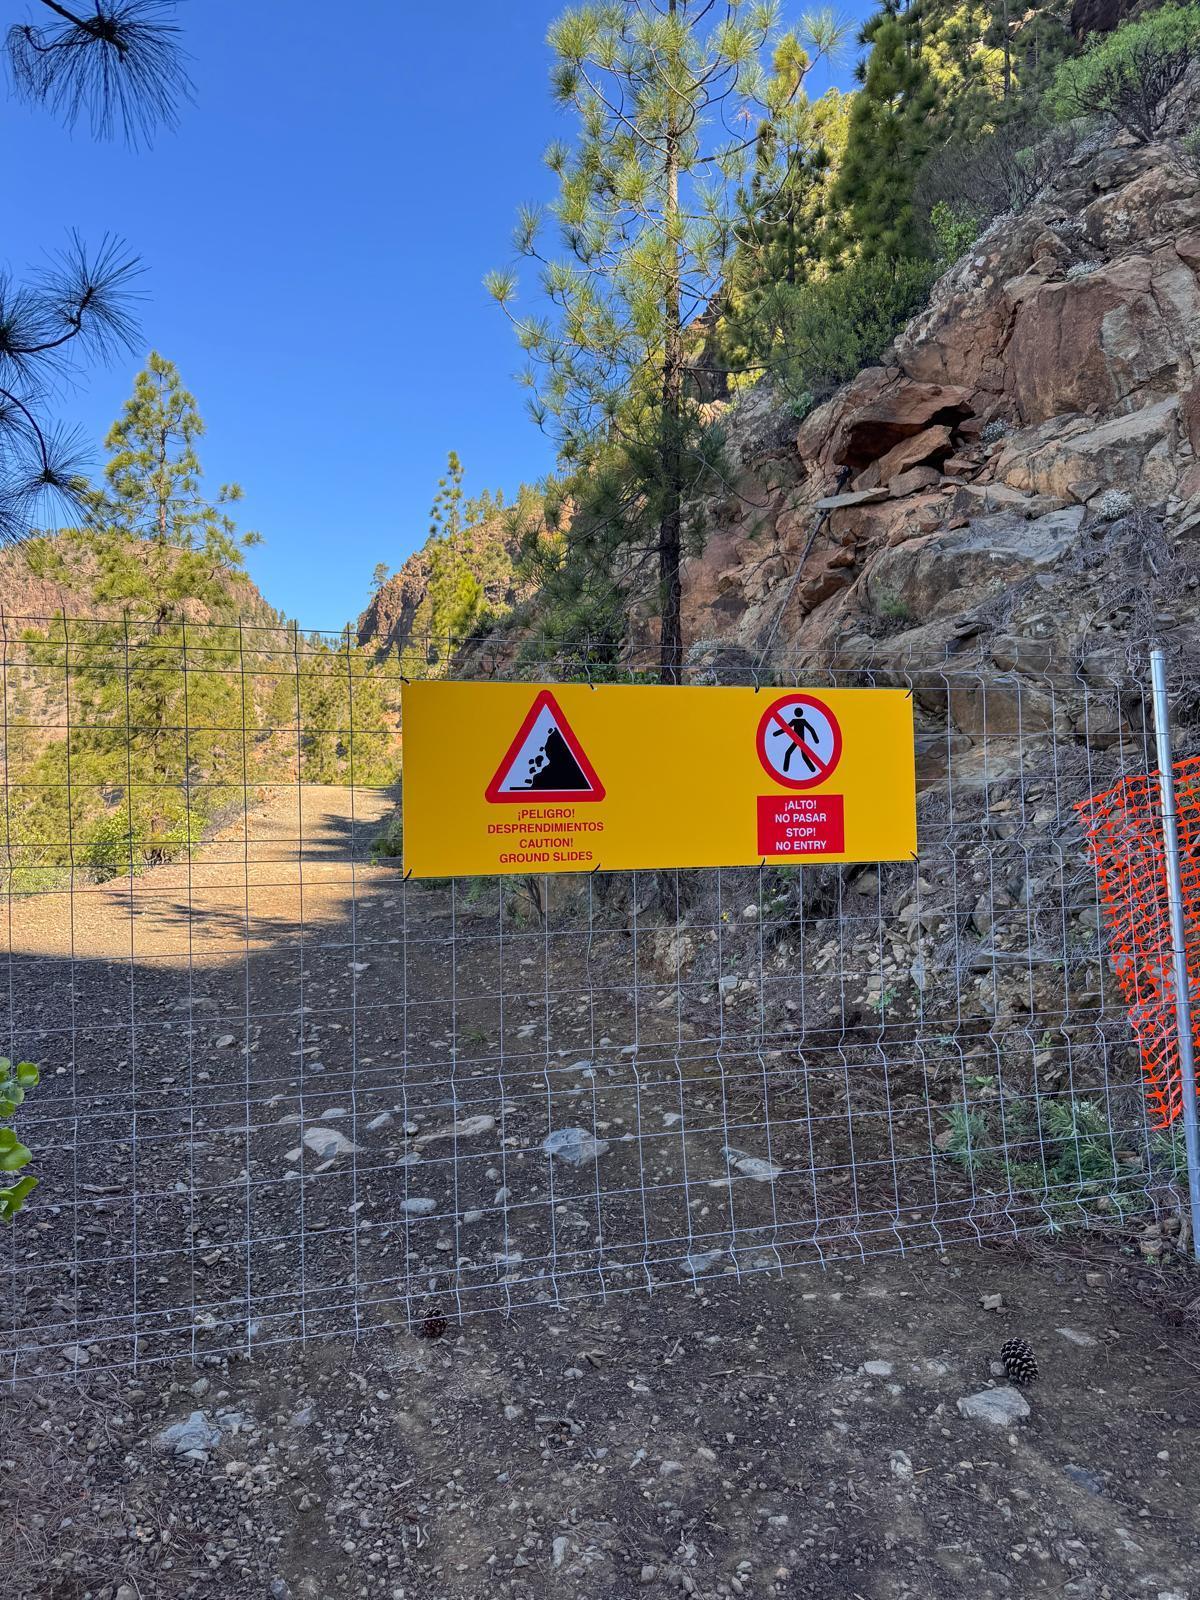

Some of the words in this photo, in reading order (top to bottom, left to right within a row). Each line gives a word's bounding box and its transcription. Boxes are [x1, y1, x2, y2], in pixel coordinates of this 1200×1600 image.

[784, 800, 817, 812] ¡ALTO!
[517, 809, 575, 821] ¡PELIGRO!
[775, 814, 790, 823] NO
[793, 813, 827, 823] PASAR
[487, 822, 604, 834] DESPRENDIMIENTOS
[786, 827, 816, 838] STOP!
[519, 838, 574, 849] CAUTION!
[776, 841, 791, 851] NO
[794, 840, 827, 850] ENTRY
[499, 852, 550, 864] GROUND
[553, 851, 593, 861] SLIDES
